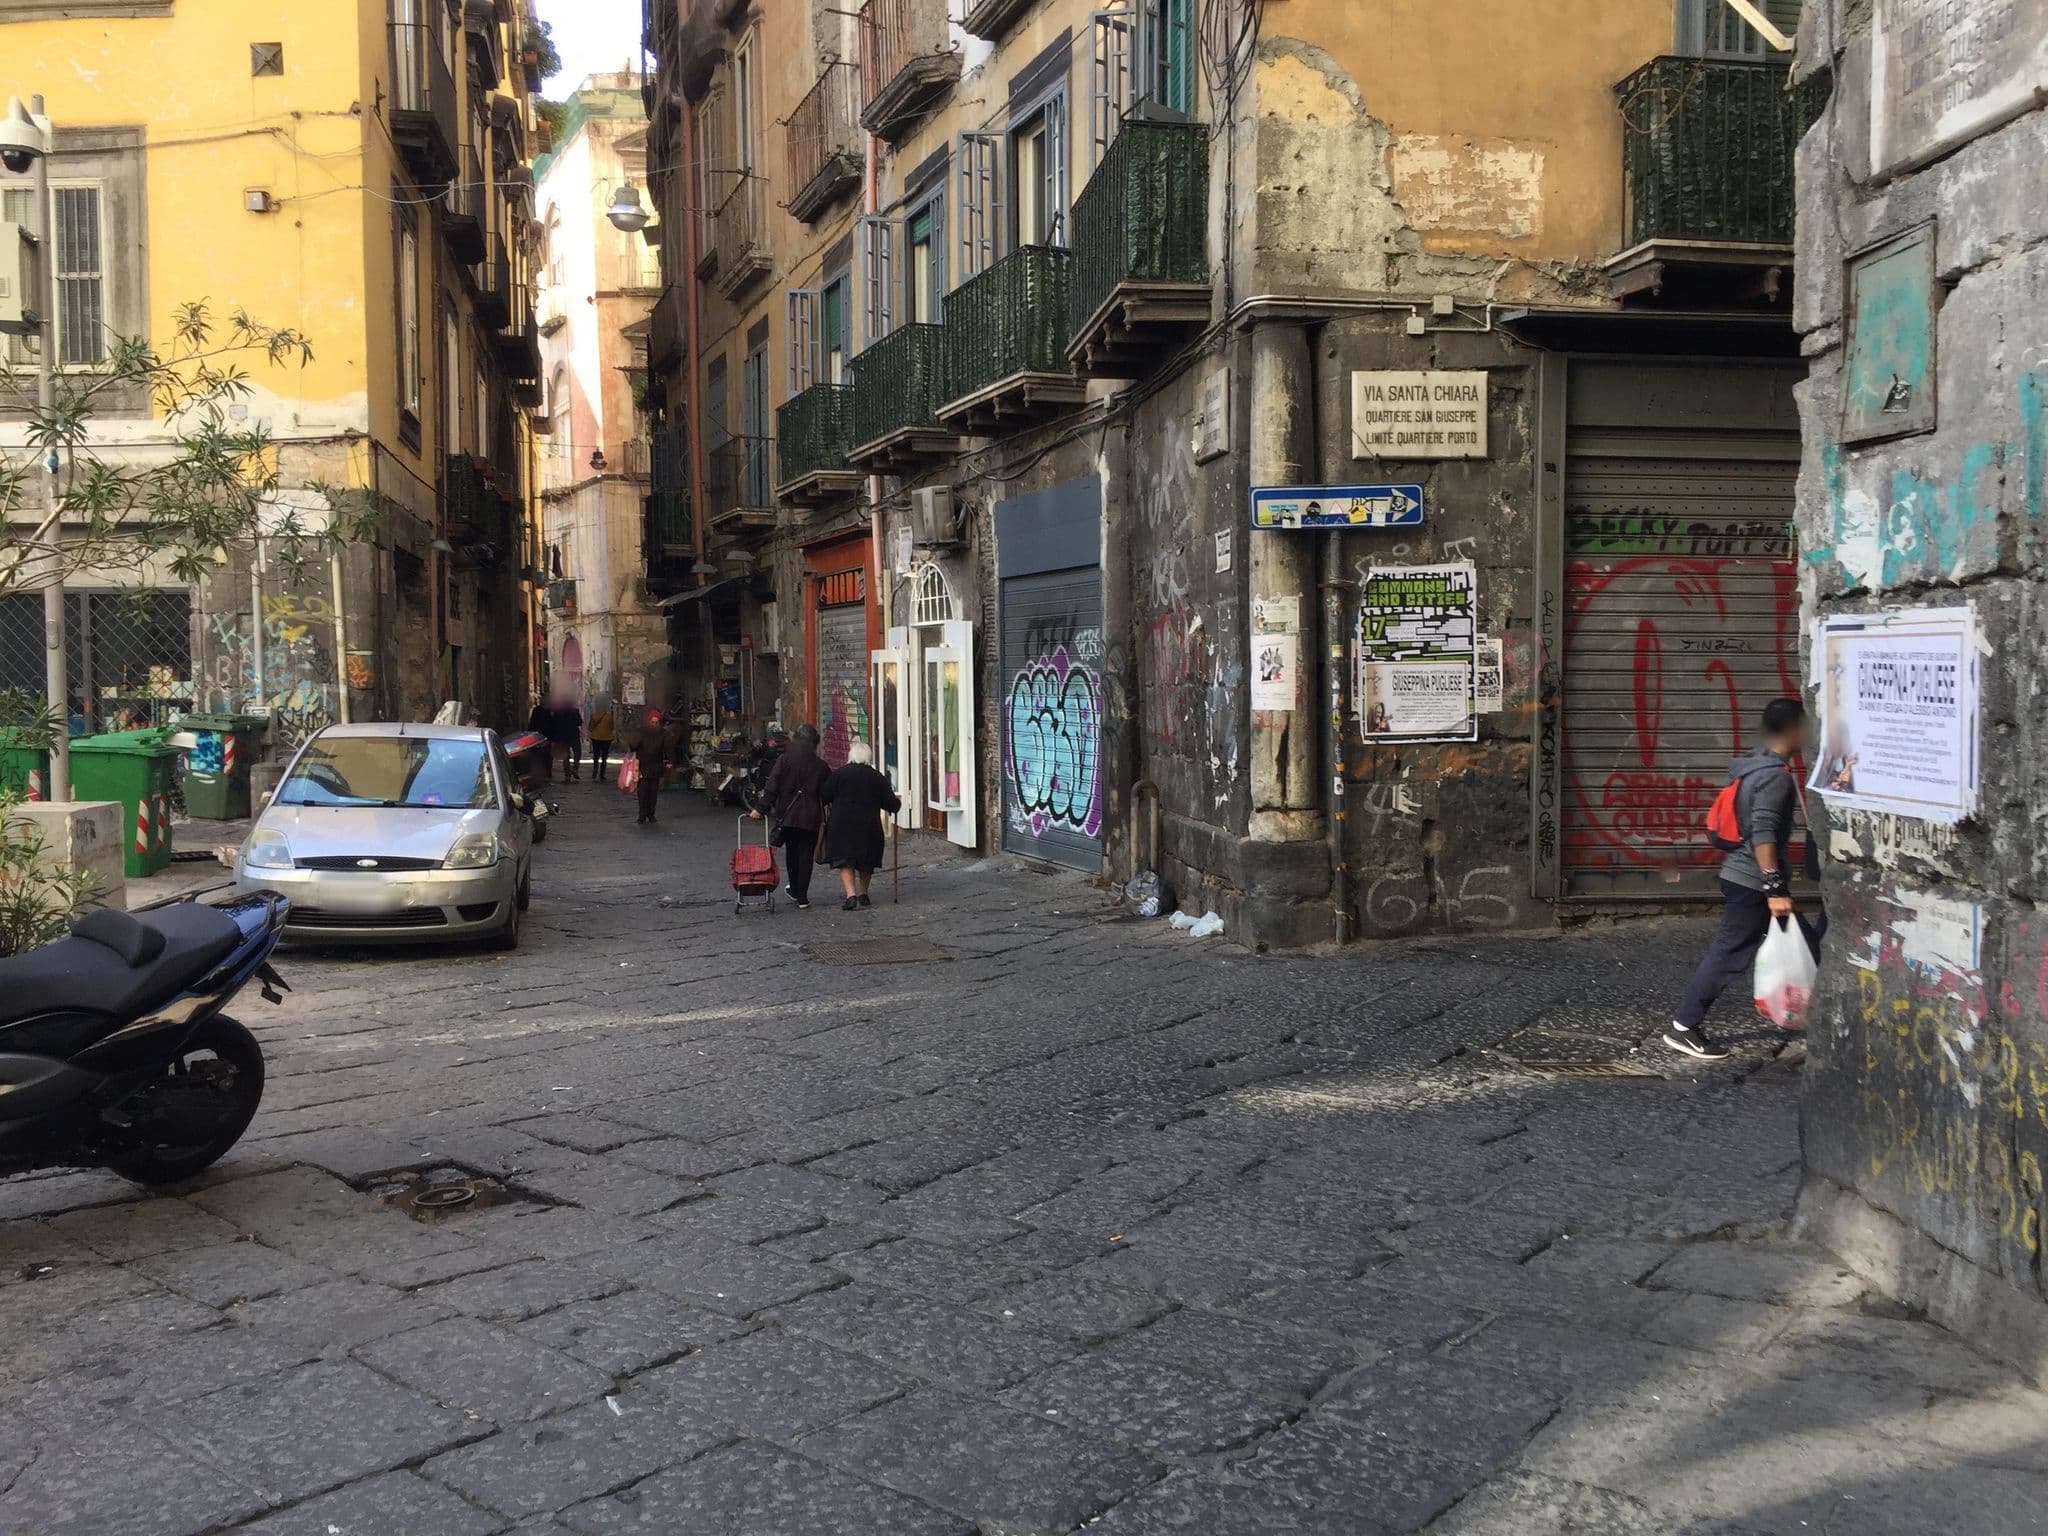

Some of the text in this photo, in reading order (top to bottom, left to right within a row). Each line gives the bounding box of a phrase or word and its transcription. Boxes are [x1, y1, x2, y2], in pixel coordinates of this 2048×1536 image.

[1364, 385, 1479, 401] VIA SANTA CHIARA
[1366, 410, 1477, 424] QUARTIERE SAN GIUSEPPE
[1366, 431, 1477, 446] LIMITE QUARTIERE PORTO
[1368, 592, 1466, 607] AND CITIES
[1362, 615, 1386, 640] 17
[1392, 674, 1462, 692] GIUSEPPINA PUGLIESE
[1858, 662, 1956, 705] GIUSEPPINA PUGLIESE
